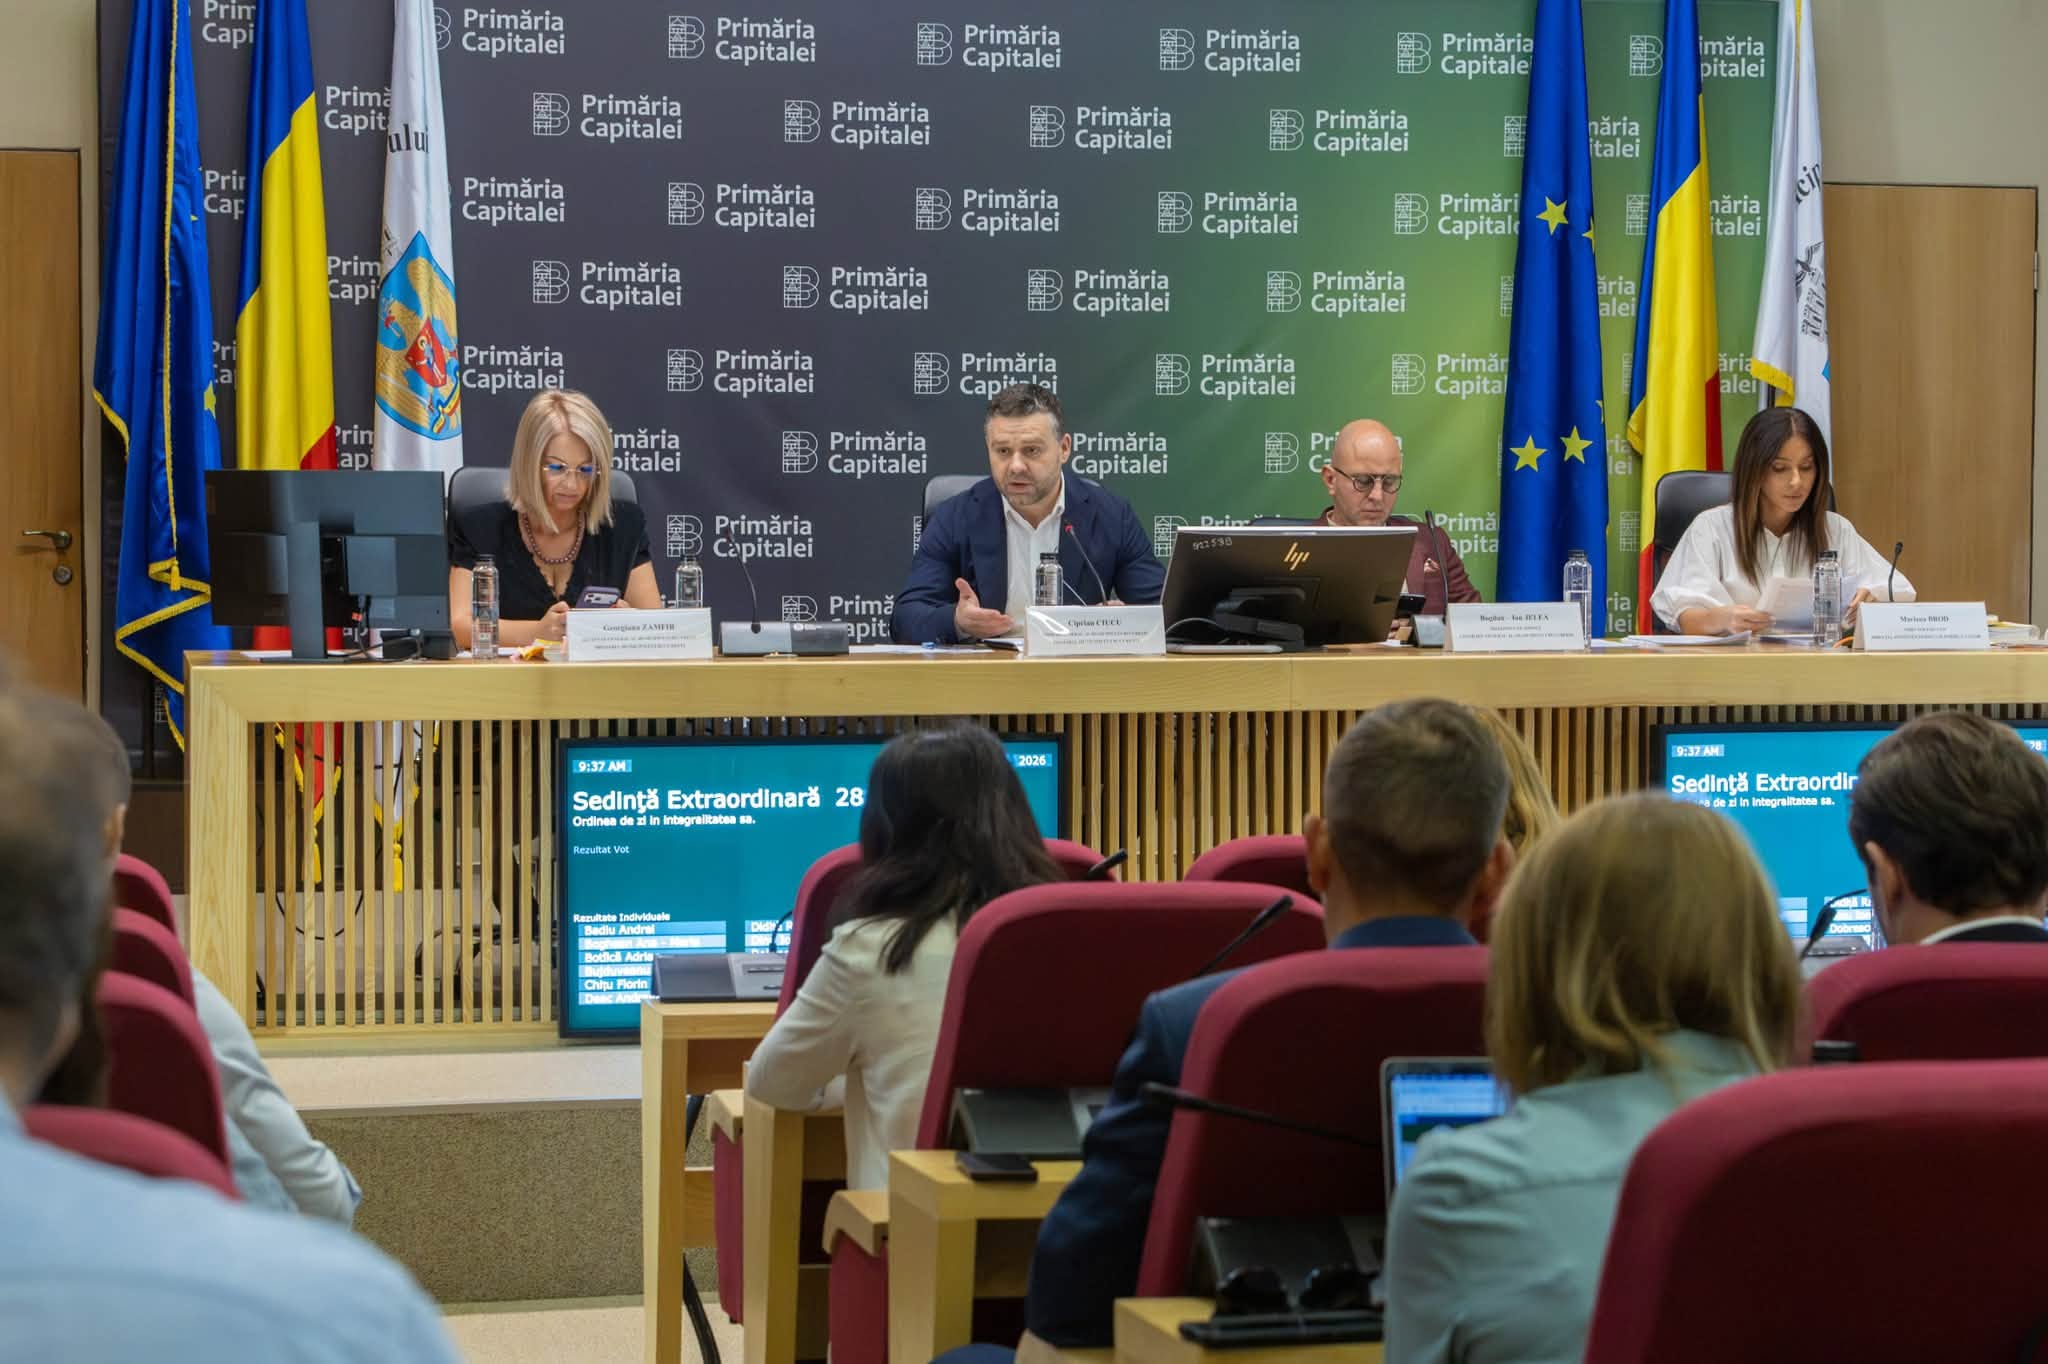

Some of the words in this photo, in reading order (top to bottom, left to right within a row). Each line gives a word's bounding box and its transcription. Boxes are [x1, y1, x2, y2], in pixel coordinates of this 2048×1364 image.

[464, 8, 563, 31] Primăria
[718, 18, 814, 39] Primăria
[462, 32, 564, 57] Capitalei
[965, 24, 1059, 45] Primăria
[1207, 30, 1299, 50] Primăria
[1443, 33, 1533, 52] Primăria
[716, 40, 815, 66] Capitalei
[1700, 36, 1764, 56] imăria
[963, 47, 1061, 72] Capitalei
[1205, 52, 1300, 77] Capitalei
[1441, 55, 1530, 79] Capitale
[1701, 58, 1765, 79] pitalei
[326, 86, 391, 107] Primă
[583, 94, 680, 116] Primăria
[324, 109, 388, 135] Capit
[833, 101, 928, 122] Primăria
[1077, 106, 1170, 126] Primăria
[1316, 110, 1408, 129] Primăria
[581, 117, 682, 143] Capitalei
[831, 124, 930, 149] Capitalei
[1075, 128, 1172, 154] Capitalei
[1314, 132, 1408, 156] Capitalei
[464, 177, 563, 199] Primăria
[717, 184, 813, 205] Primăria
[964, 189, 1058, 209] Primăria
[1205, 192, 1297, 211] Primăria
[1440, 193, 1519, 212] Primări
[463, 201, 565, 226] Capitalei
[715, 207, 815, 232] Capitalei
[962, 211, 1059, 236] Capitalei
[1203, 214, 1298, 239] Capitalei
[1438, 215, 1520, 240] Capital
[328, 256, 381, 276] Prim
[583, 262, 680, 283] Primăria
[832, 267, 927, 287] Primăria
[1075, 269, 1168, 289] Primăria
[1313, 271, 1404, 290] Primăria
[1597, 276, 1636, 295] ăria
[581, 285, 681, 310] Capitalei
[830, 289, 928, 314] Capitalei
[1073, 292, 1169, 317] Capitalei
[1311, 292, 1406, 317] Capitalei
[464, 345, 563, 366] Primăria
[716, 350, 812, 370] Primăria
[962, 352, 1056, 372] Primăria
[1202, 354, 1294, 373] Primăria
[1437, 353, 1508, 372] Primăr
[462, 368, 564, 393] Capitalei
[714, 372, 814, 398] Capitalei
[1200, 375, 1295, 400] Capitalei
[1435, 374, 1507, 400] Capital
[831, 431, 925, 451] Primăria
[1073, 432, 1166, 452] Primăria
[611, 451, 681, 472] pitalei
[829, 453, 927, 479] Capitalei
[1072, 454, 1168, 480] Capitalei
[716, 515, 811, 535] Primăria
[1434, 512, 1496, 532] Primă
[713, 537, 813, 563] Capitalei
[1283, 542, 1310, 571] hp
[830, 595, 894, 615] Primă
[1018, 754, 1047, 767] 2026
[1676, 747, 1700, 757] 9:37
[1703, 746, 1719, 756] AM
[578, 761, 605, 772] 9:37
[608, 761, 626, 772] AM
[667, 786, 820, 810] Extraordinară
[835, 787, 864, 807] 28
[1713, 797, 1725, 807] de
[1728, 797, 1737, 807] zi
[572, 816, 617, 827] Ordinea
[619, 815, 634, 826] de
[637, 815, 646, 826] zi
[663, 814, 736, 827] integralitatea
[740, 815, 755, 825] sa.
[574, 846, 611, 855] Rezultat
[613, 845, 629, 854] Vot
[573, 913, 617, 923] Rezultate
[619, 912, 670, 922] Individuale
[625, 951, 654, 962] Adria
[617, 979, 647, 990] Florin
